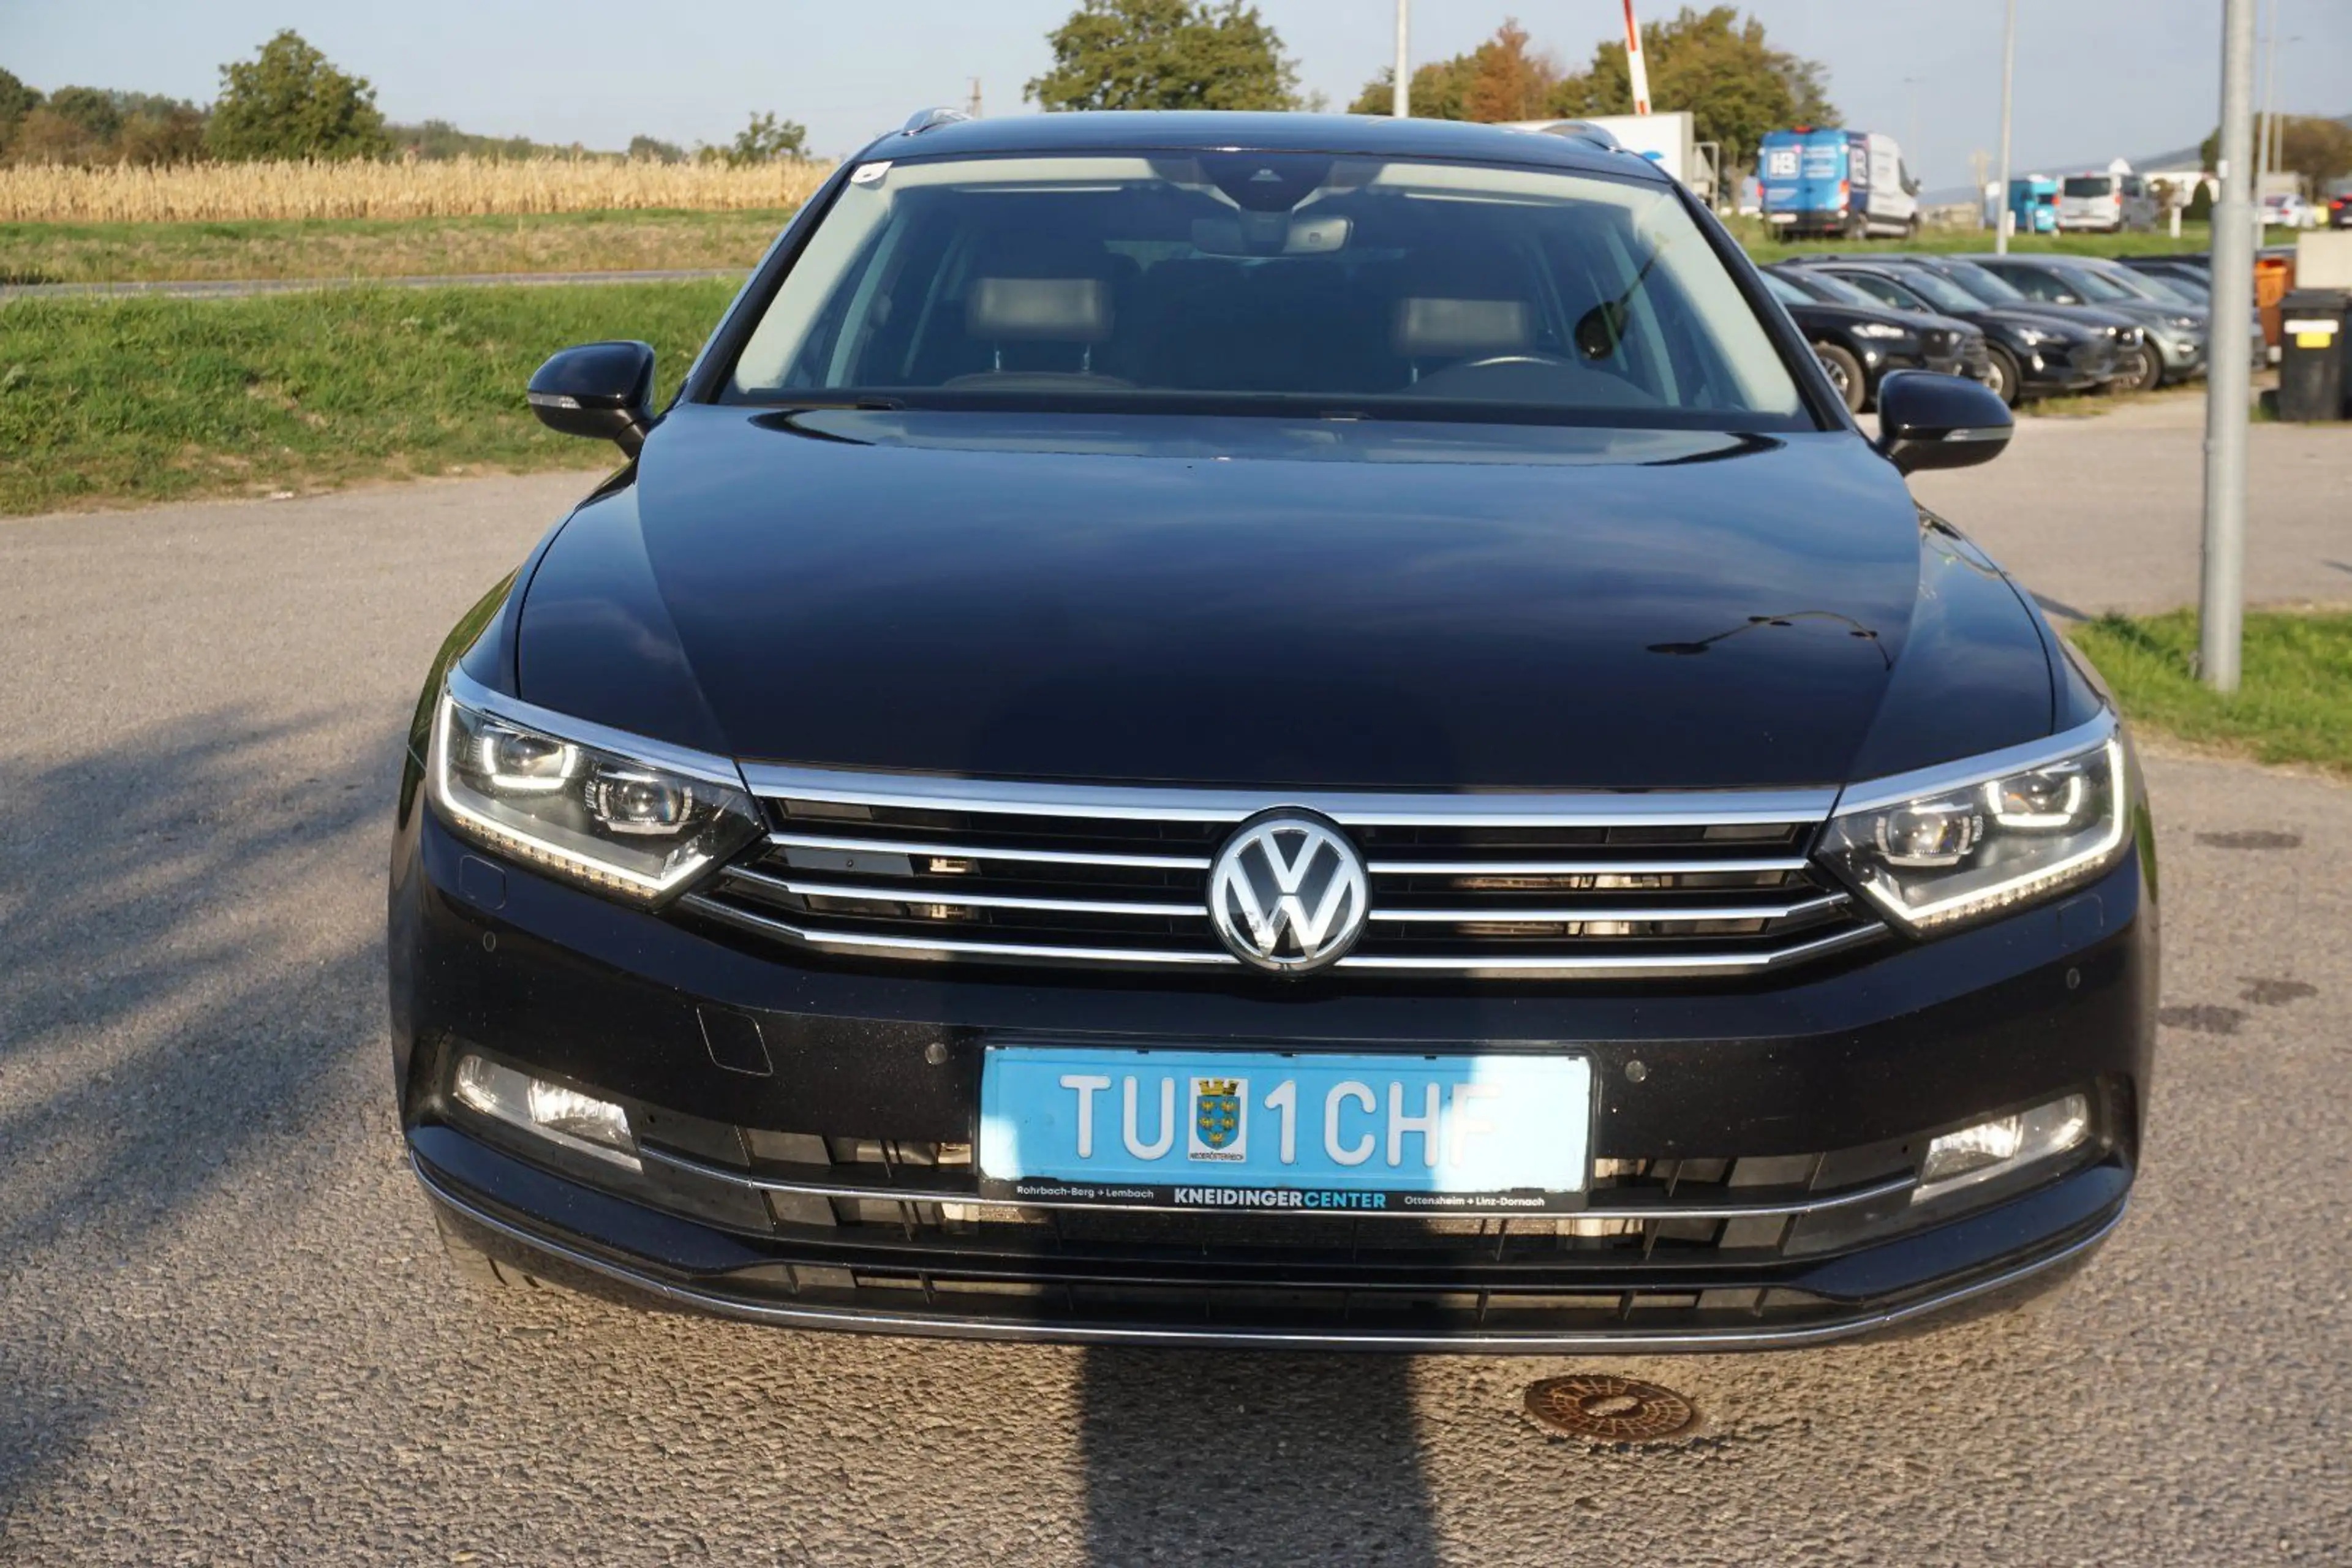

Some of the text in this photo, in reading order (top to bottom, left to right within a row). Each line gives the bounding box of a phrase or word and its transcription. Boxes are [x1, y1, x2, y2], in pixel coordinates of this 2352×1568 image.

[1060, 1075, 1175, 1161] TU
[1017, 1186, 1155, 1199] Rohrbach-Berg Lembach
[1404, 1196, 1545, 1207] Ottensheim Linz-Dornach
